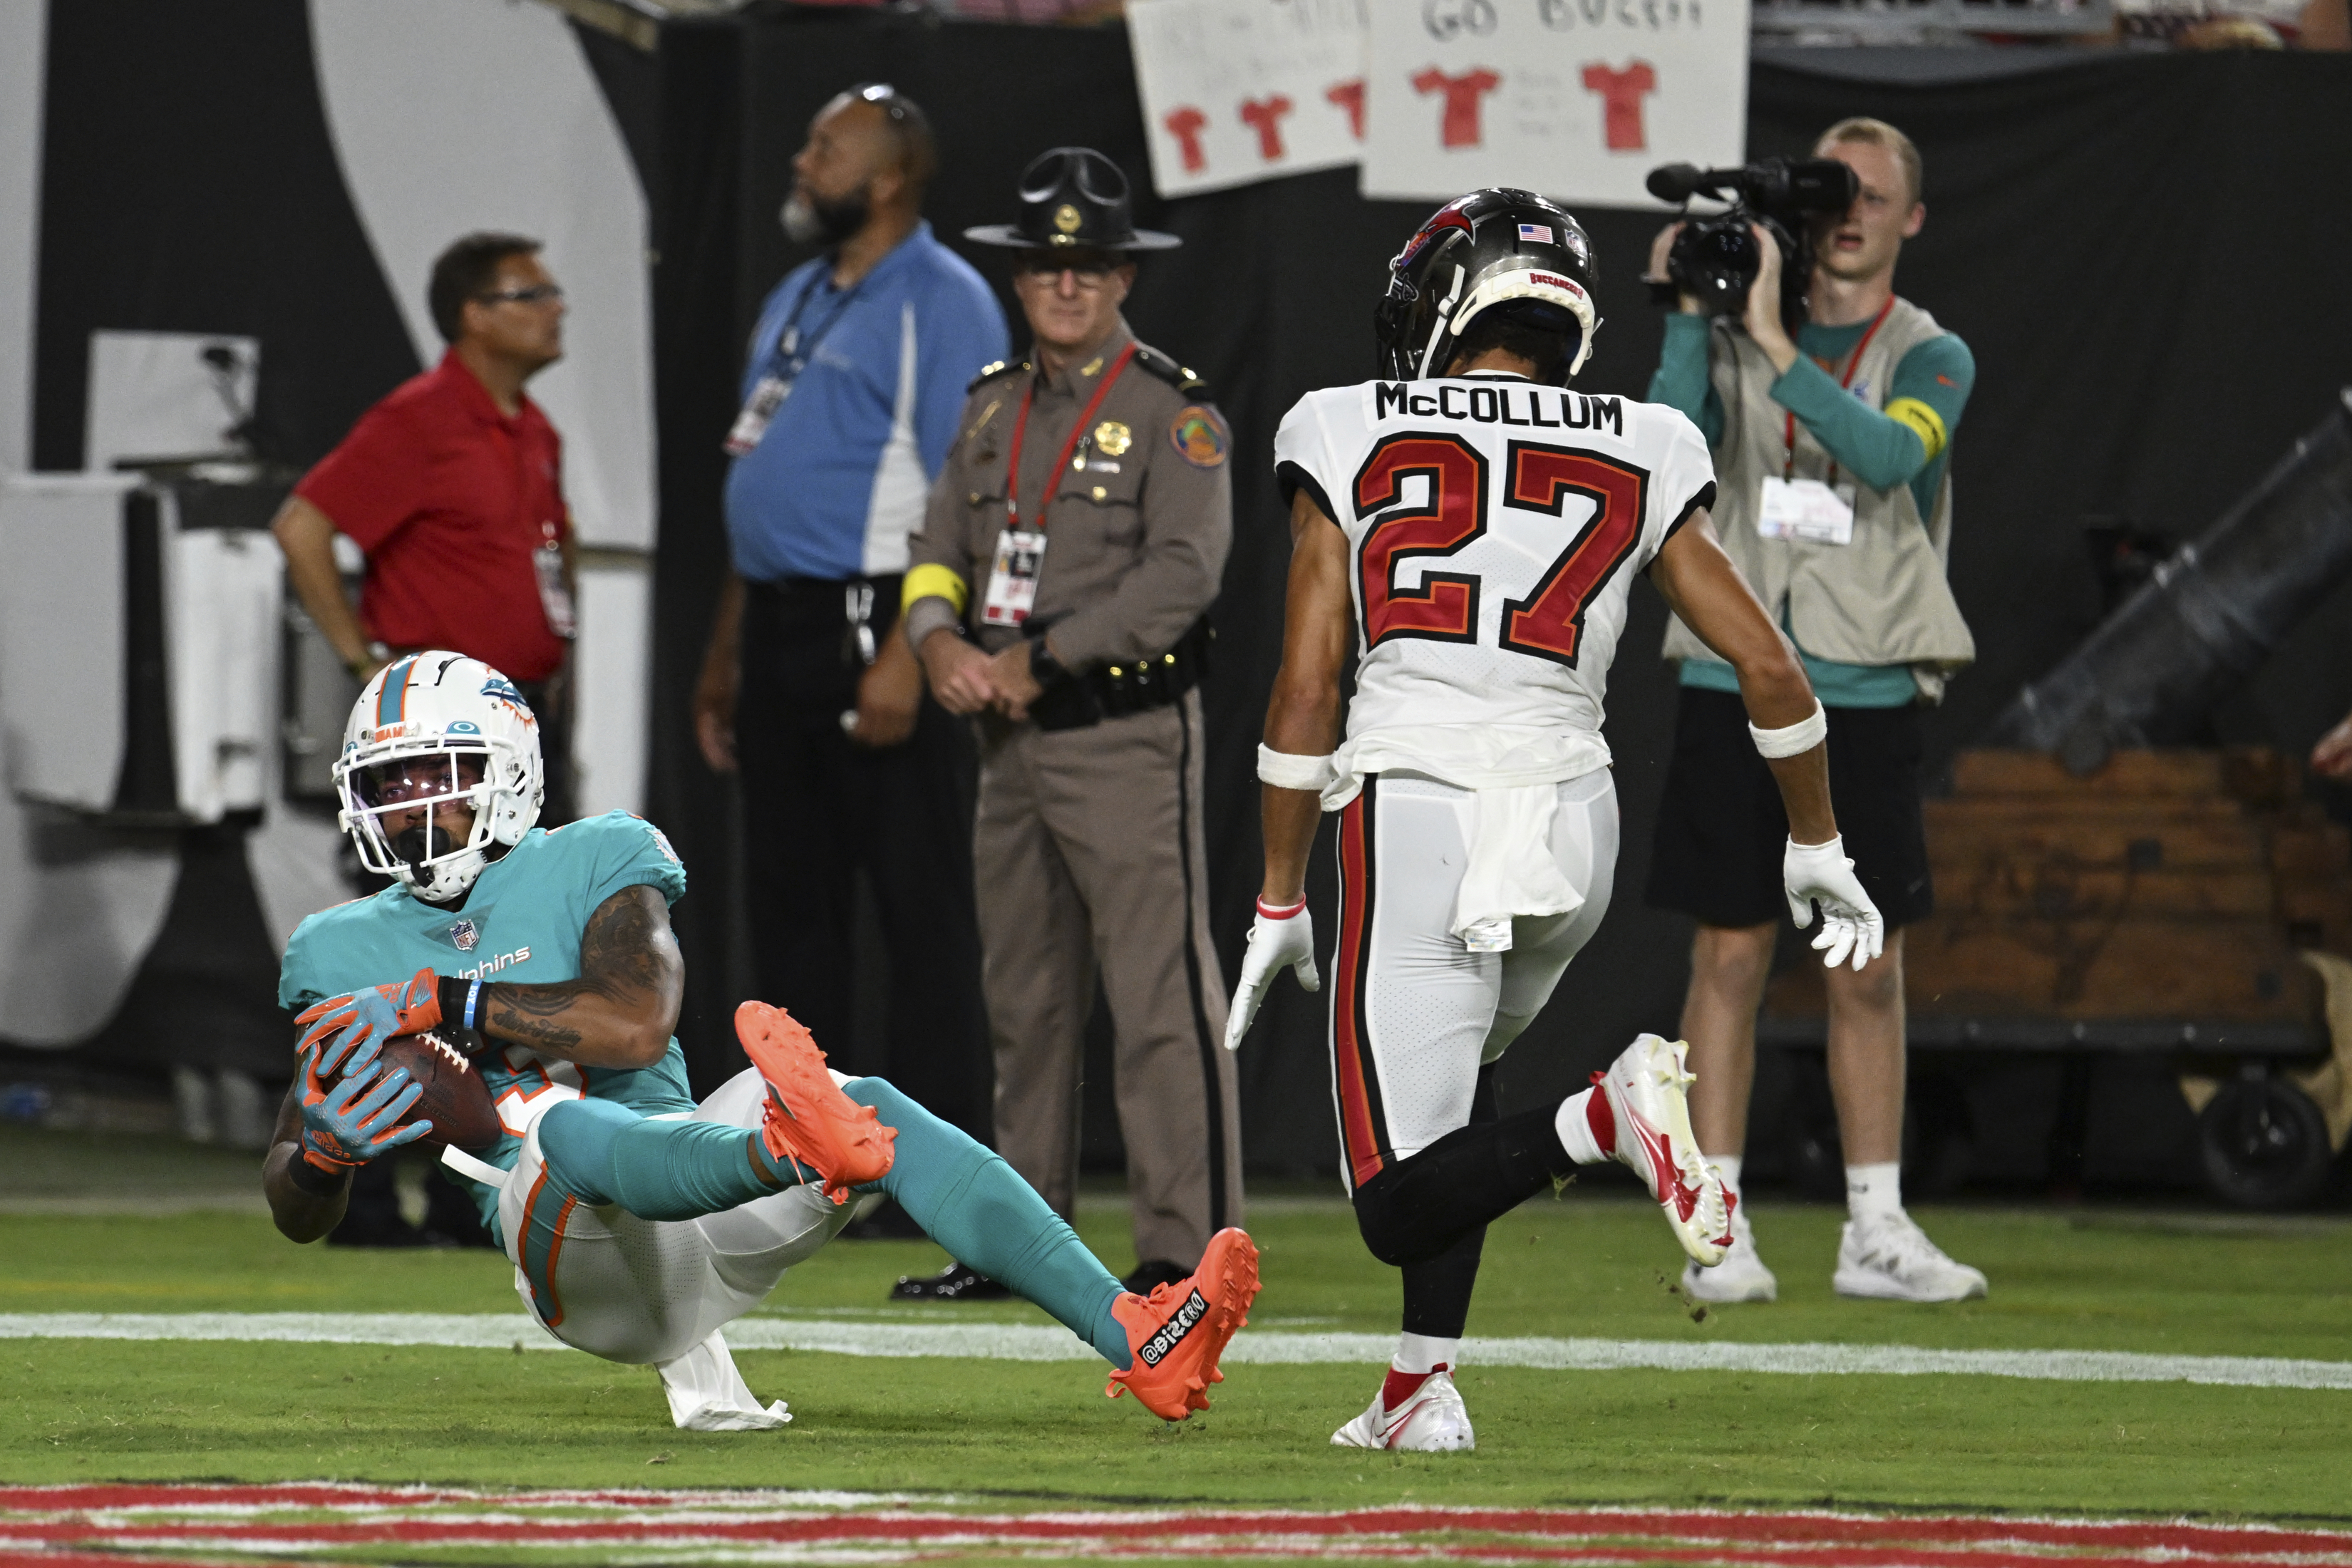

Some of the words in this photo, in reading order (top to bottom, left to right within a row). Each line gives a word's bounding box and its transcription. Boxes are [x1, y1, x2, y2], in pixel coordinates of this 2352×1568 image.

[1376, 381, 1623, 437] McCOLLUM
[1352, 430, 1651, 669] 27
[458, 932, 476, 947] NFL
[467, 986, 478, 1004] BOY
[432, 1107, 458, 1128] LEAGUE
